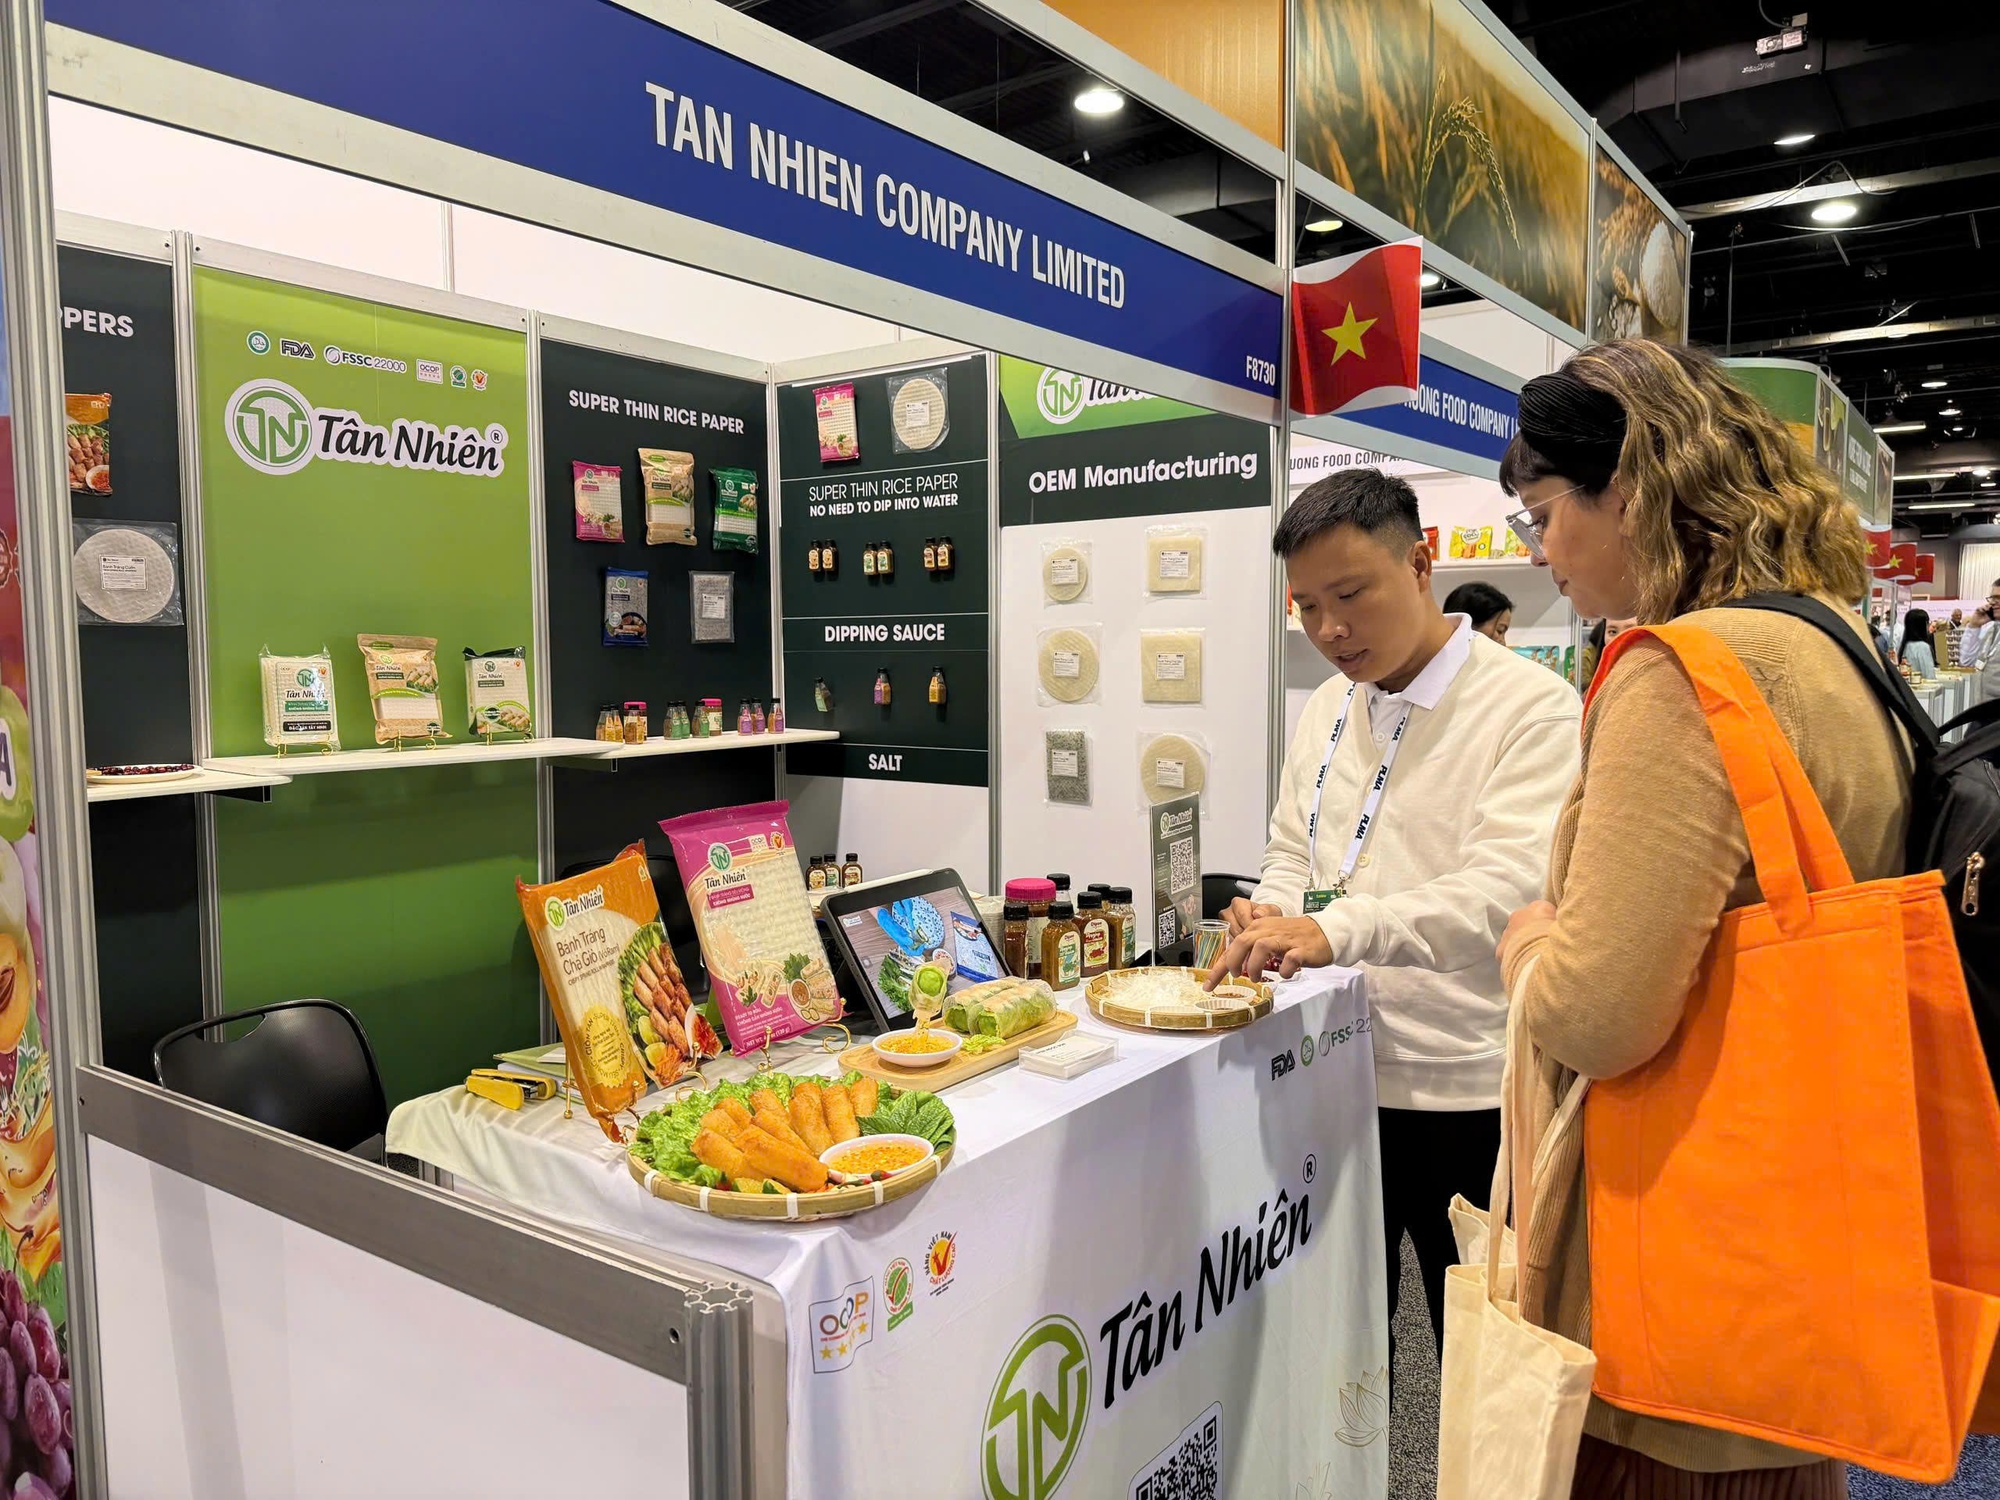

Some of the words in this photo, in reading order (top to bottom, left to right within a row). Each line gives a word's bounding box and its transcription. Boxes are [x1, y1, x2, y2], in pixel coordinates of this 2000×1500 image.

[646, 81, 733, 170] TAN
[750, 122, 863, 217] NHIEN
[876, 173, 1022, 272] COMPANY
[1032, 234, 1125, 309] LIMITED
[57, 306, 134, 338] PERS
[280, 340, 315, 359] FDA
[342, 352, 373, 367] FSSC
[374, 357, 406, 372] 22000
[1246, 355, 1276, 386] F8730
[568, 389, 619, 414] SUPER
[624, 399, 660, 421] THIN
[664, 405, 697, 427] RICE
[702, 412, 744, 435] PAPER
[1442, 392, 1467, 426] FOOD
[1469, 402, 1510, 440] COMPANY
[318, 414, 386, 458] Tân
[1028, 468, 1077, 494] OEM
[1084, 451, 1258, 489] Manufacturing
[1323, 453, 1351, 468] FOOD
[809, 483, 847, 502] SUPER
[850, 480, 879, 498] THIN
[882, 478, 912, 496] RICE
[916, 473, 958, 492] PAPER
[810, 504, 826, 517] NO
[828, 502, 854, 516] NEED
[857, 501, 871, 513] TO
[874, 499, 892, 512] DIP
[894, 496, 920, 511] INTO
[922, 493, 958, 508] WATER
[824, 625, 889, 642] DIPPING
[893, 623, 945, 641] SAUCE
[1330, 718, 1342, 742] PLMA
[868, 753, 903, 772] SALT
[1316, 763, 1327, 789] PLMA
[1373, 764, 1388, 792] PLMA
[1355, 813, 1370, 841] PLMA
[704, 878, 721, 889] Tân
[563, 901, 580, 917] Tân
[580, 891, 603, 912] Nhiên
[556, 936, 580, 957] Bánh
[579, 928, 606, 947] Tráng
[581, 948, 598, 967] Giò
[1271, 1049, 1296, 1081] FDA
[1100, 1290, 1186, 1409] Tân
